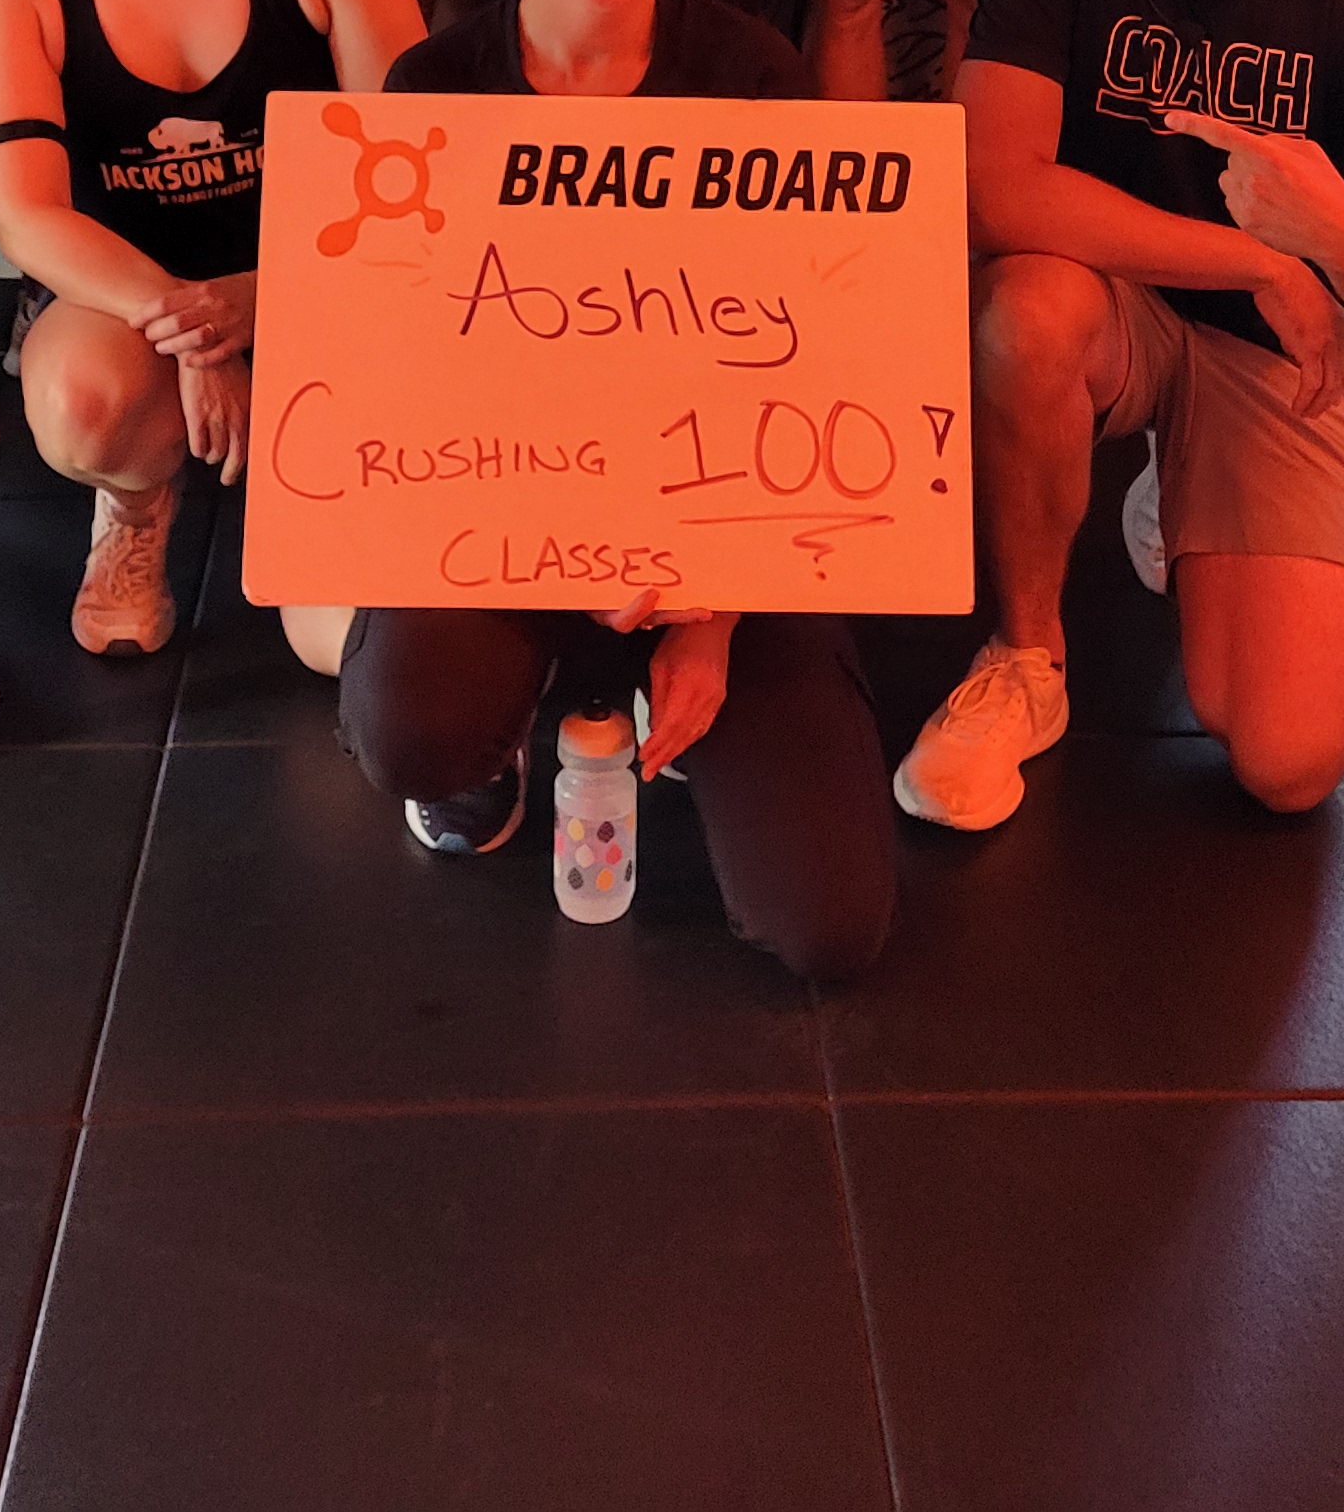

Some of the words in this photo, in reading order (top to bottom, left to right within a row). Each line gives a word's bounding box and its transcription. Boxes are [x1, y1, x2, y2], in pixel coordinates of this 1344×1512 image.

[1103, 15, 1314, 131] COACH
[498, 144, 674, 208] BRAG
[690, 146, 913, 214] BOARD
[447, 241, 799, 368] Ashley
[439, 528, 683, 589] CLASSES
